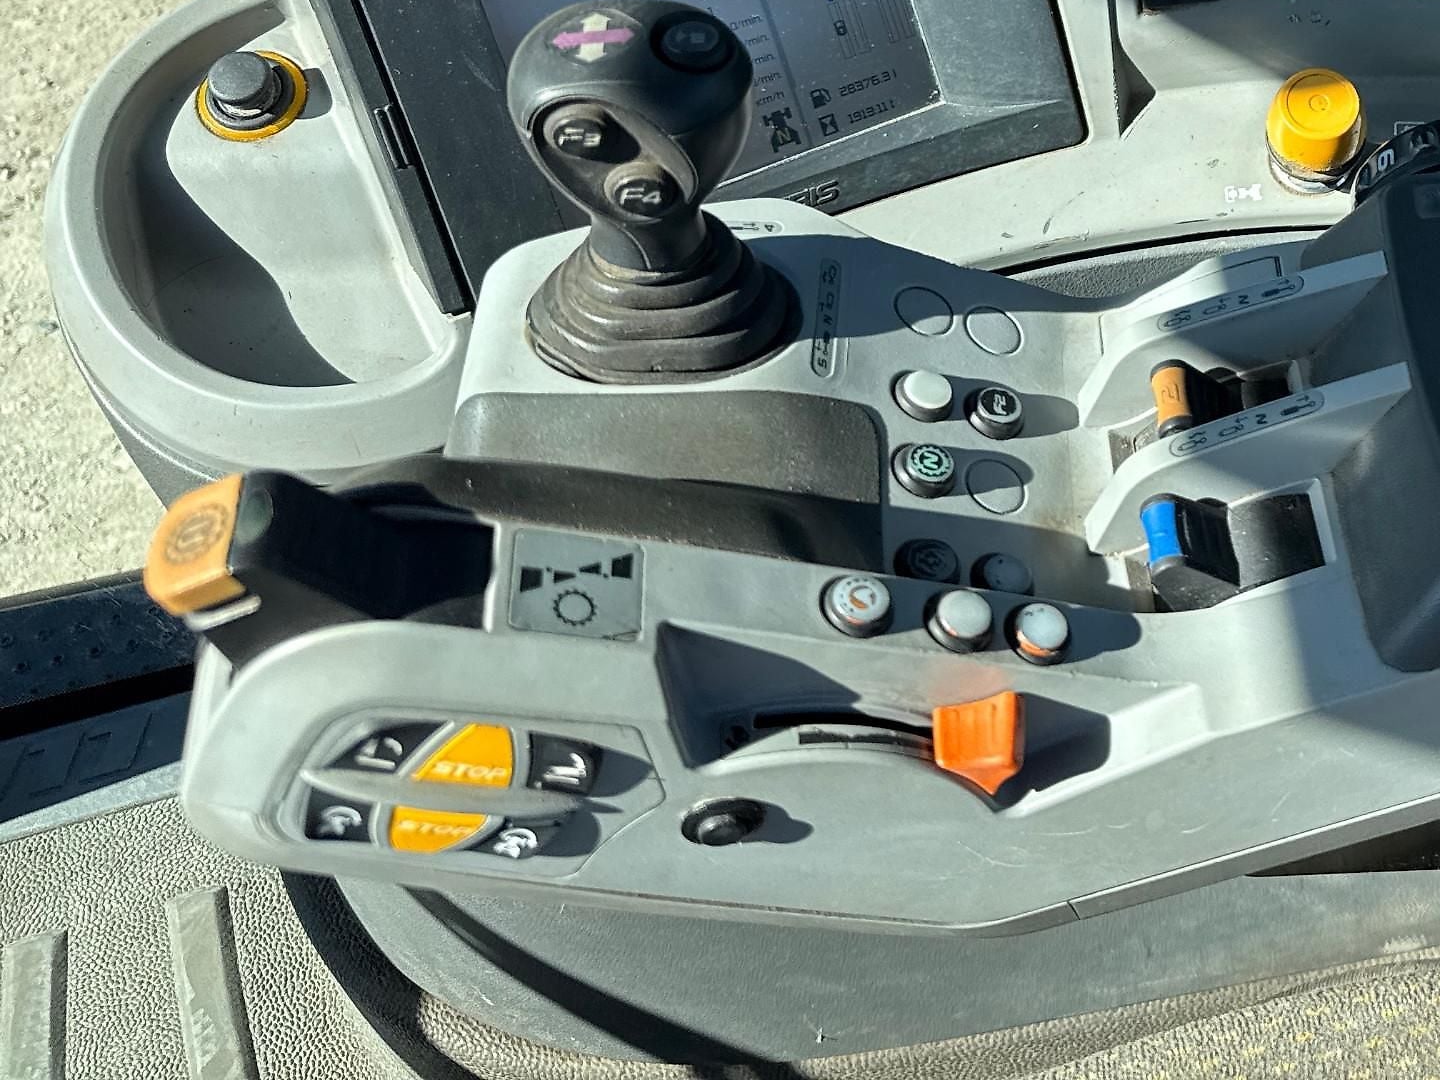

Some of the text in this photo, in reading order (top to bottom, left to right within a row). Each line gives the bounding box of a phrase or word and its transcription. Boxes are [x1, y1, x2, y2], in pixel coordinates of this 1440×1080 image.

[558, 127, 601, 147] F3
[619, 187, 662, 205] F4
[926, 453, 941, 470] N
[432, 760, 508, 780] STOP
[399, 820, 472, 837] STOP
